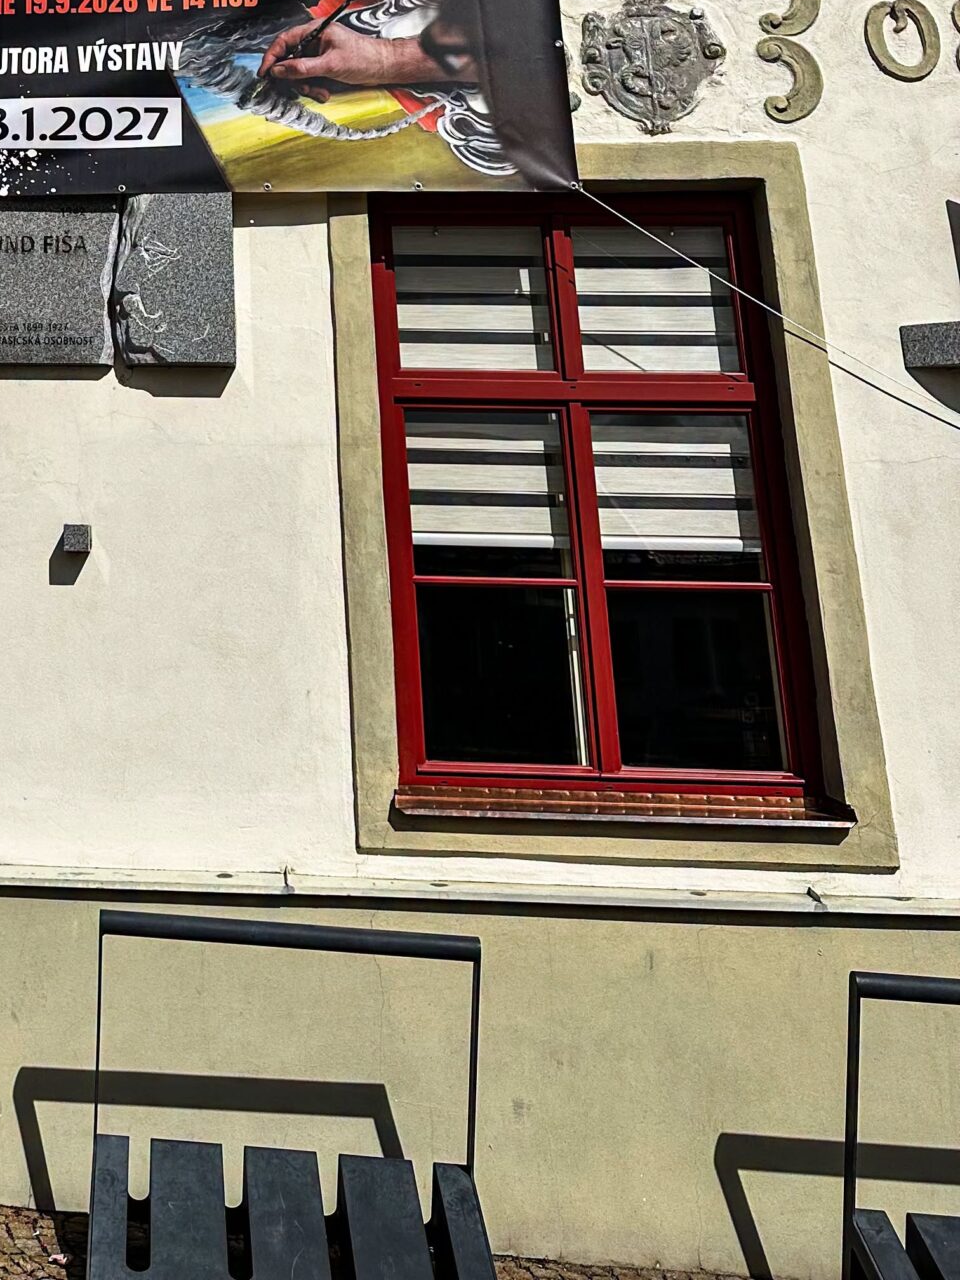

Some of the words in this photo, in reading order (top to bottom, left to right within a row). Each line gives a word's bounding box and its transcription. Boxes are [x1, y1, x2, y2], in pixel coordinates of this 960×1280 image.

[77, 38, 183, 71] VÝSTAVY
[43, 230, 88, 254] FIŠA
[43, 335, 95, 346] OSOBNOST
